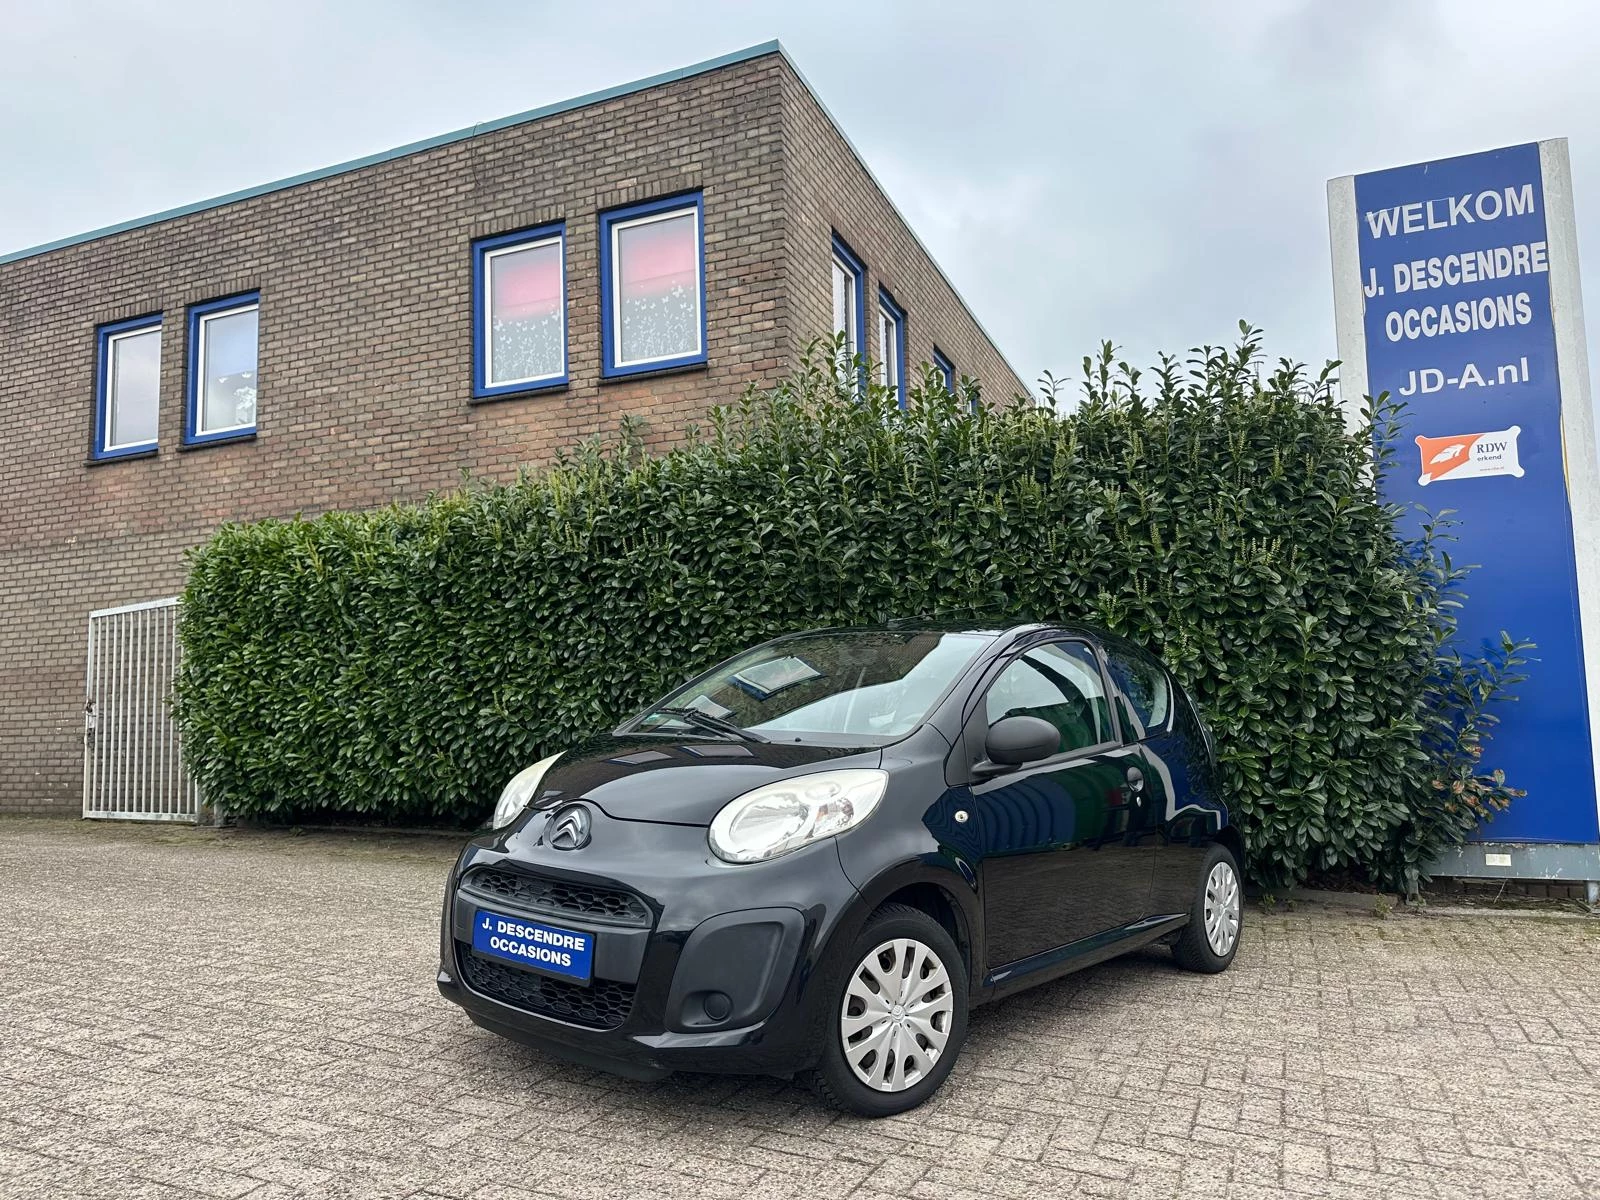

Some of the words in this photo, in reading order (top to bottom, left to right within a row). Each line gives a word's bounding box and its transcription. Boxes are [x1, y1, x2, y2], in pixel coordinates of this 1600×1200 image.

[1367, 183, 1535, 239] WELKOM
[1364, 267, 1385, 298] J.
[1393, 241, 1549, 294] DESCENDRE
[1385, 292, 1532, 342] OCCASIONS
[1398, 356, 1529, 396] JD-A.nl
[1476, 441, 1508, 454] RDW
[1477, 454, 1502, 462] erkend
[482, 917, 493, 931] J.
[497, 920, 586, 952] DESCENDRE
[490, 936, 571, 967] OCCASIONS
